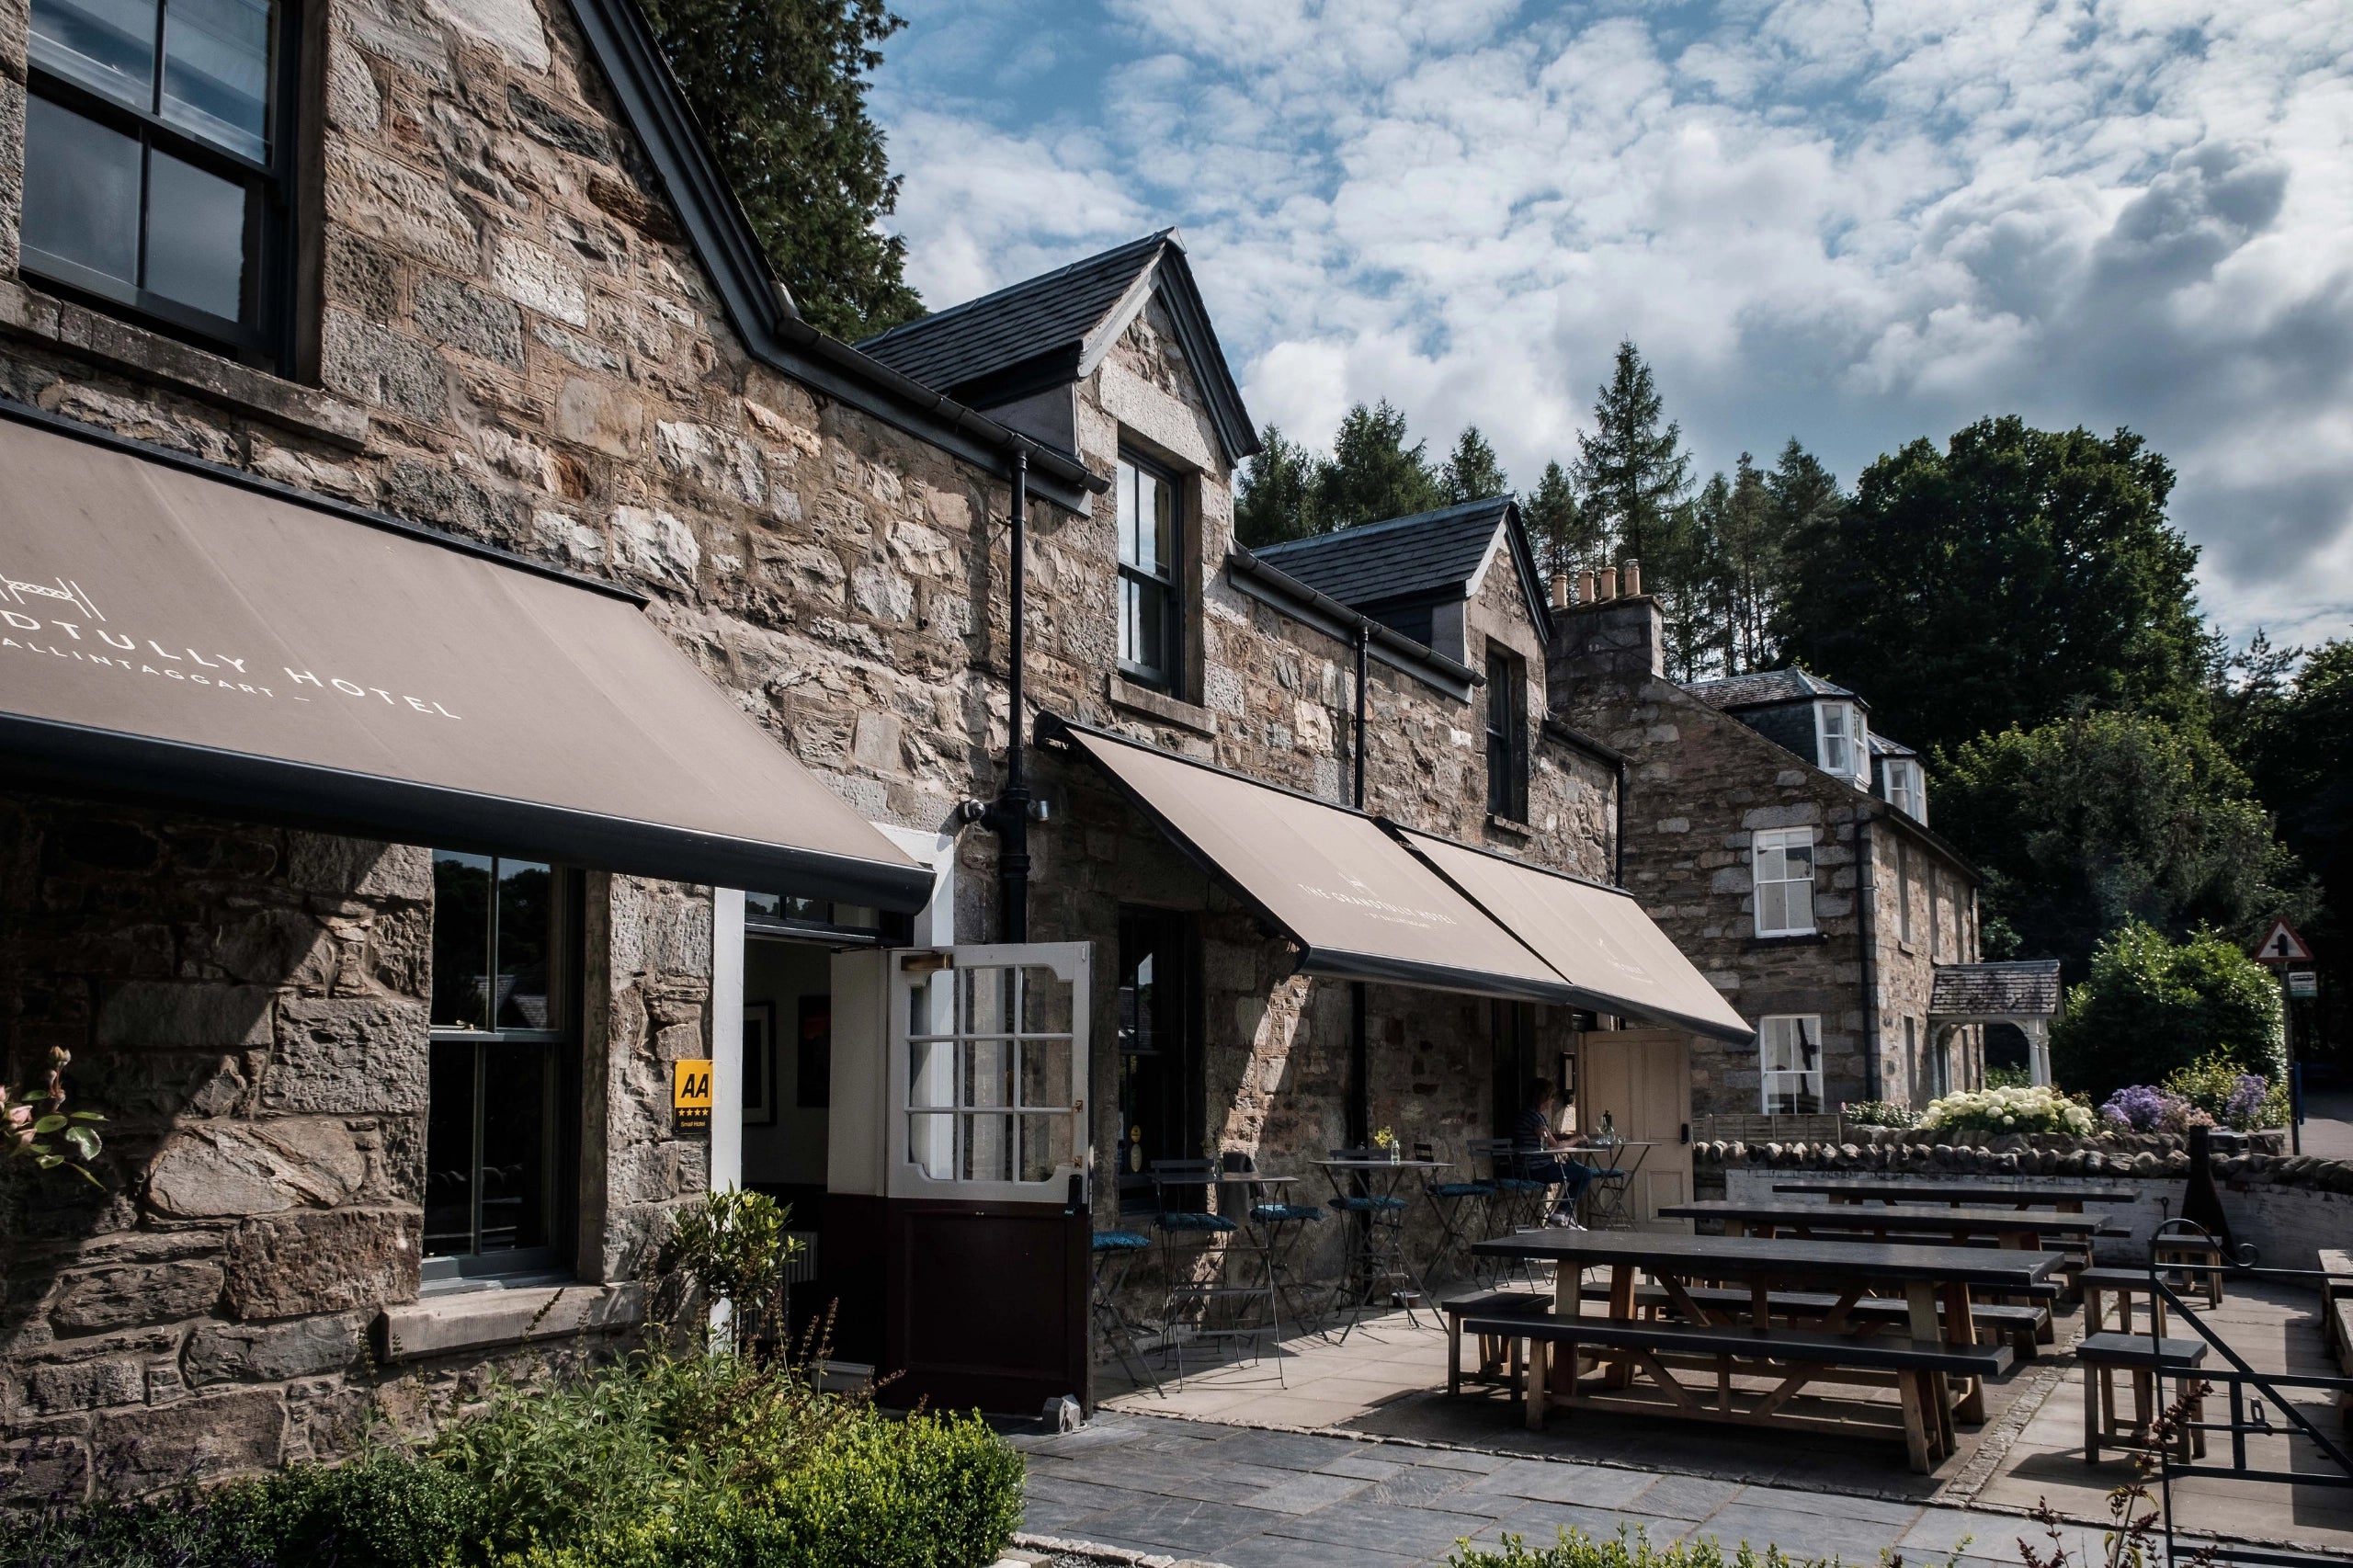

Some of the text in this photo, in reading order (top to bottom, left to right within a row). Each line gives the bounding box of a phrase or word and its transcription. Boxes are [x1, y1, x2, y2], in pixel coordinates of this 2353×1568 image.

[284, 667, 461, 720] HOTEL
[1297, 883, 1330, 899] THE
[1415, 908, 1457, 925] HOTEL
[681, 1073, 709, 1098] AA
